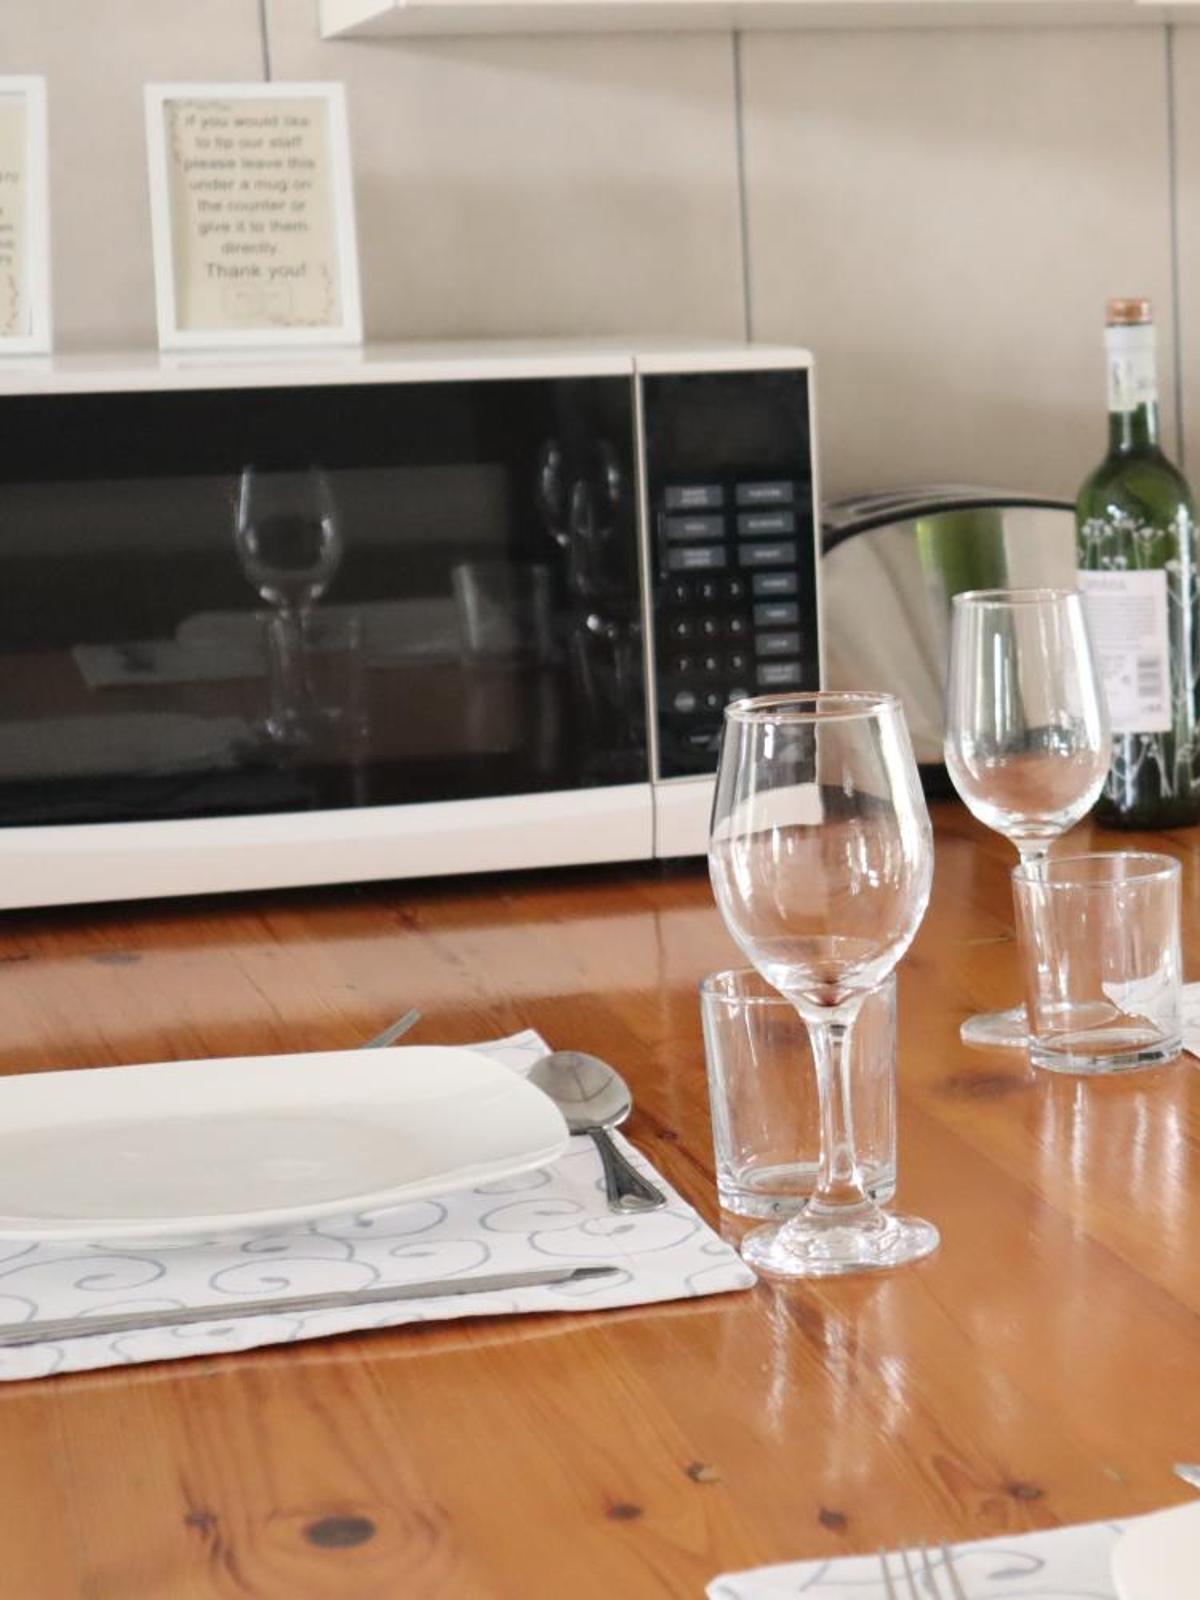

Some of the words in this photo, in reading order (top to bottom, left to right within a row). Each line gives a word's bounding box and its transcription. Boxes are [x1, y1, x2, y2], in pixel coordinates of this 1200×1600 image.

[200, 117, 228, 129] you
[233, 115, 279, 127] would
[183, 158, 236, 172] please
[241, 158, 282, 169] leave
[287, 157, 315, 169] this
[189, 178, 234, 190] under
[254, 180, 287, 193] mug
[197, 199, 222, 211] the
[227, 200, 286, 211] counter
[198, 221, 230, 236] give
[206, 262, 261, 278] Thank
[269, 262, 306, 279] you!
